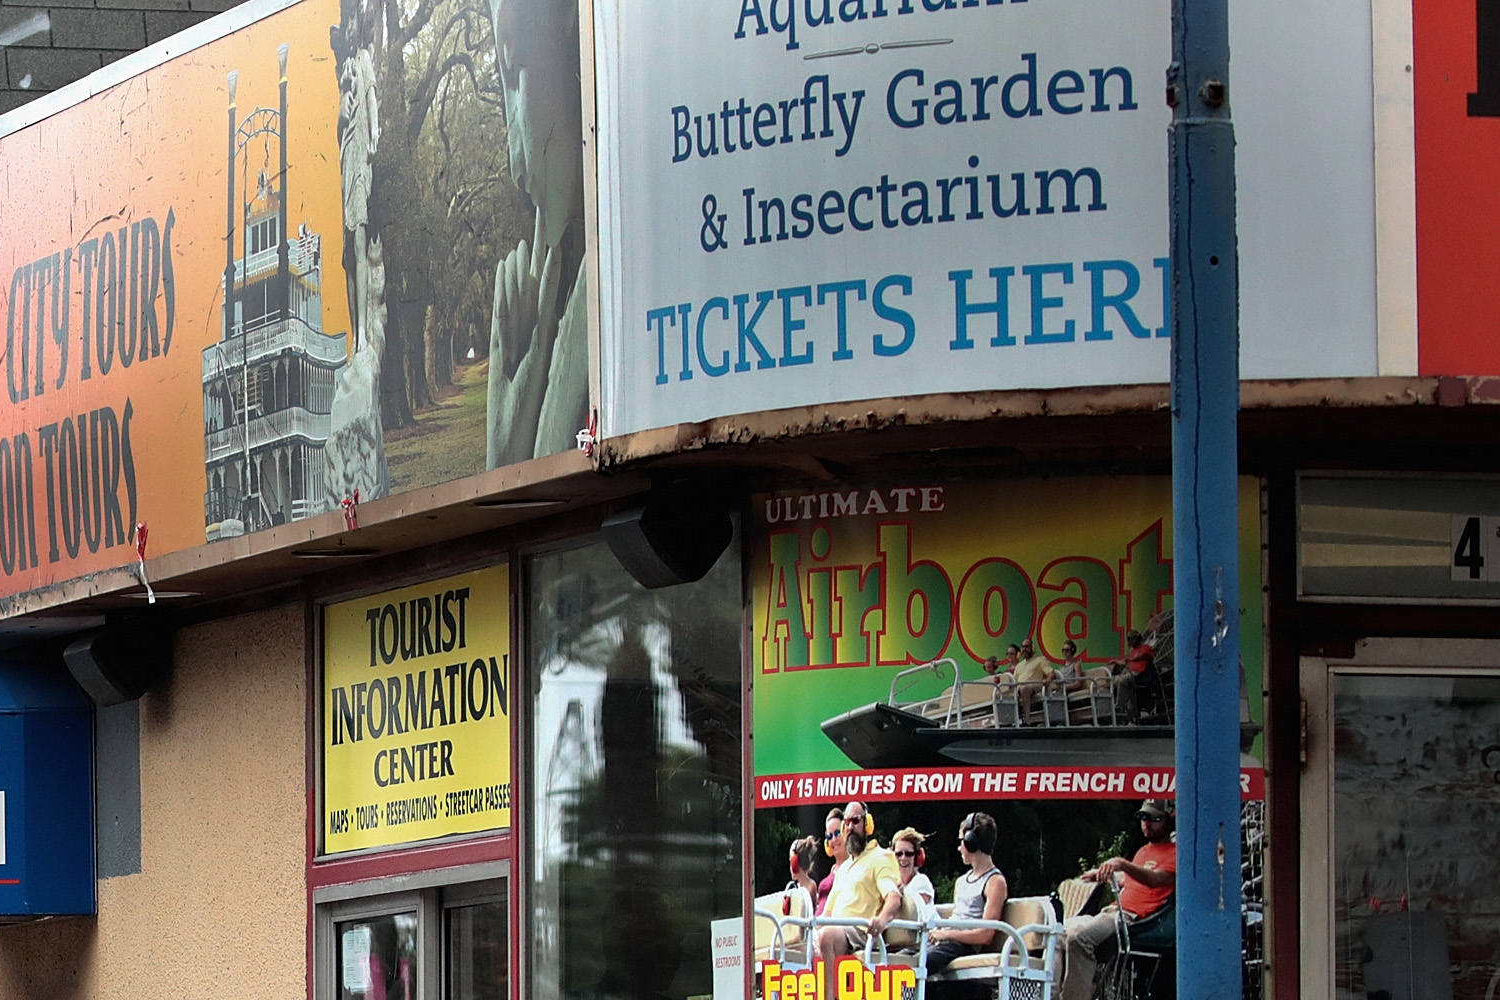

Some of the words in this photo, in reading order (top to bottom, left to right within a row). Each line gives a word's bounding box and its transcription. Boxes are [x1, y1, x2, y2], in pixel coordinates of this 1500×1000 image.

[671, 73, 863, 163] Butterfly
[886, 52, 1140, 131] Garden
[700, 204, 729, 253] &
[742, 156, 1108, 246] Insectarium
[5, 240, 75, 405] CITY
[77, 206, 176, 383] TOURS
[646, 273, 917, 387] TICKETS
[39, 397, 138, 564] TOURS
[764, 485, 946, 525] ULTIMATE
[366, 586, 470, 668] TOURIST
[330, 653, 509, 747] INFORMATION
[374, 739, 455, 788] CENTER
[761, 780, 794, 801] ONLY
[796, 779, 814, 799] 15
[816, 775, 896, 798] MINUTES
[901, 774, 963, 794] FROM
[970, 773, 1018, 793] THE
[1024, 772, 1126, 793] FRENCH
[329, 808, 349, 835] MAPS
[356, 804, 379, 831] TOURS
[386, 795, 438, 827] RESERVATIONS
[445, 787, 484, 818] STREETCAR
[485, 782, 511, 812] PASSES
[715, 937, 723, 949] NO
[723, 935, 738, 948] PUBLIC
[715, 955, 742, 969] RESTROOMS
